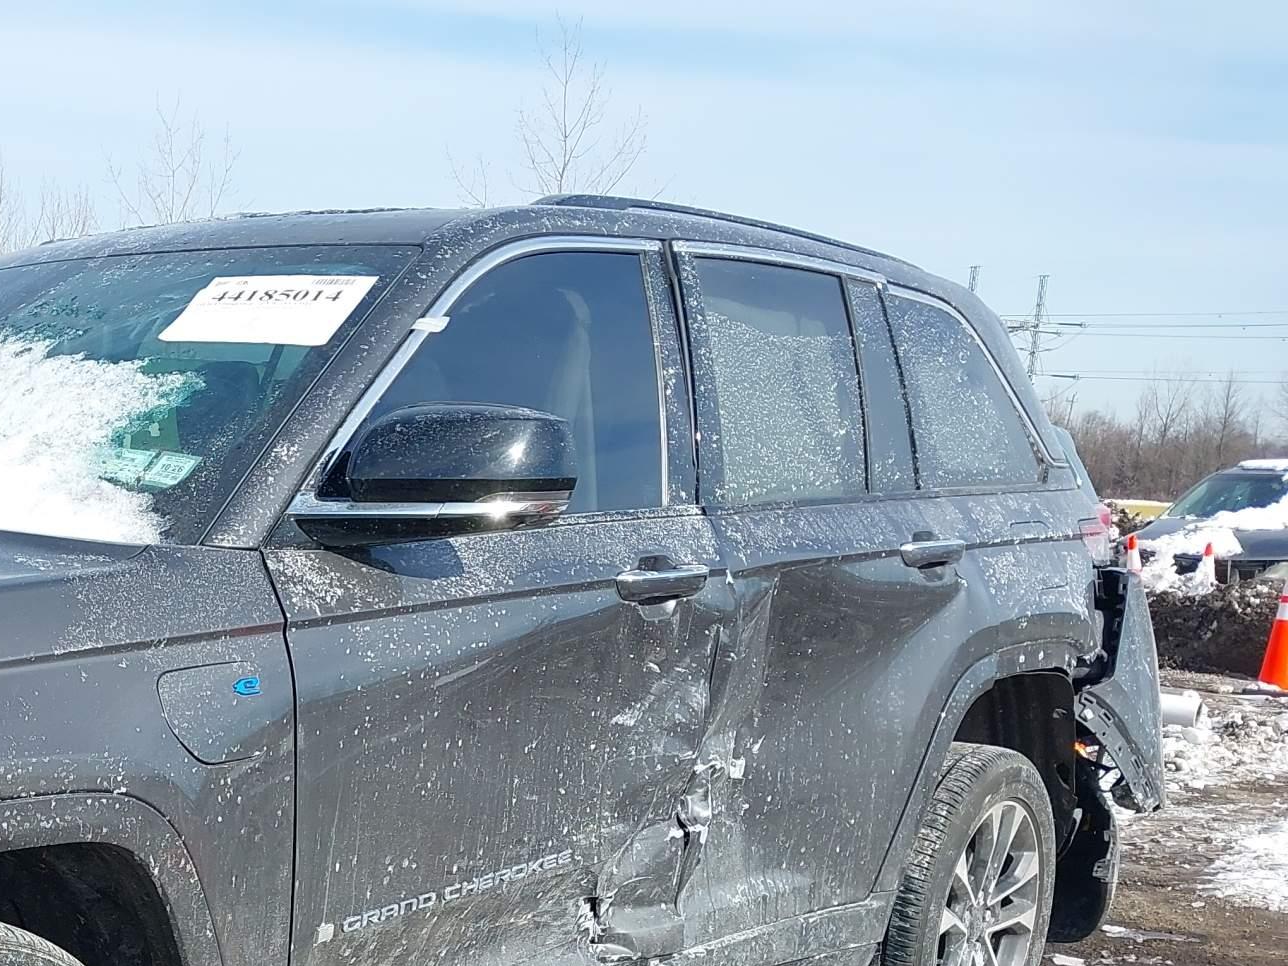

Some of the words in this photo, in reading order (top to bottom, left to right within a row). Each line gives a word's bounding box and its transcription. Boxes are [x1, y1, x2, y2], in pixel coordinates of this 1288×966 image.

[211, 289, 344, 302] 44185014
[342, 891, 437, 934] GRAND
[443, 848, 574, 901] CHEROKEE
